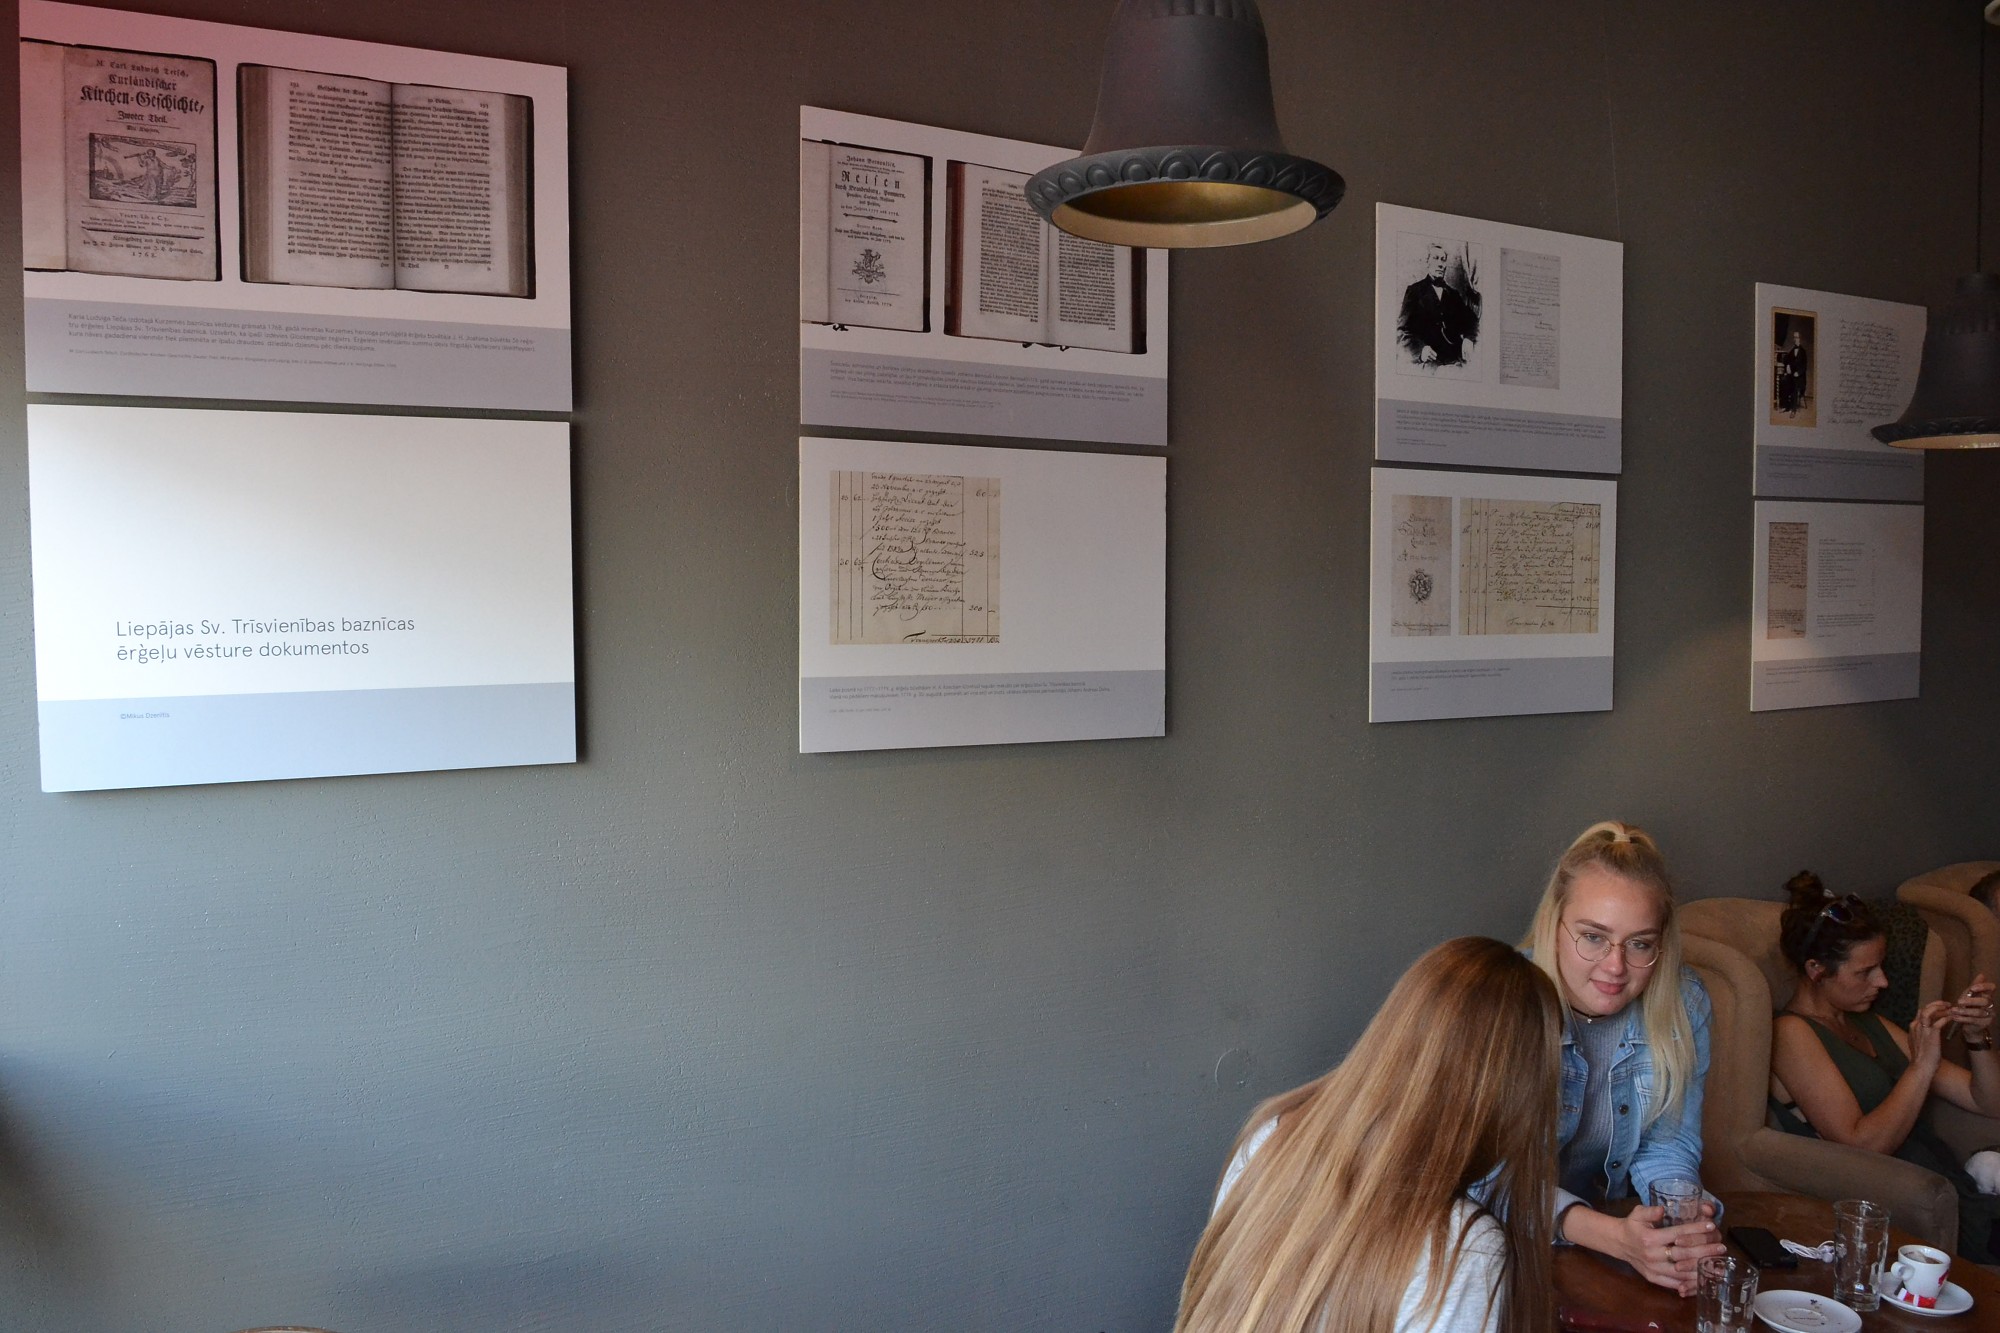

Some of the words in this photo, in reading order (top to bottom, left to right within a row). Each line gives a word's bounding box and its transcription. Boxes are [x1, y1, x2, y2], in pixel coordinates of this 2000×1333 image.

[842, 170, 900, 189] Reisen
[116, 620, 194, 639] Liepājas
[200, 620, 226, 635] Sv.
[232, 618, 335, 634] Trīsvienības
[342, 617, 415, 632] baznīcas
[117, 644, 177, 664] ērģeļu
[184, 642, 252, 659] vēsture
[259, 640, 369, 656] dokumentos
